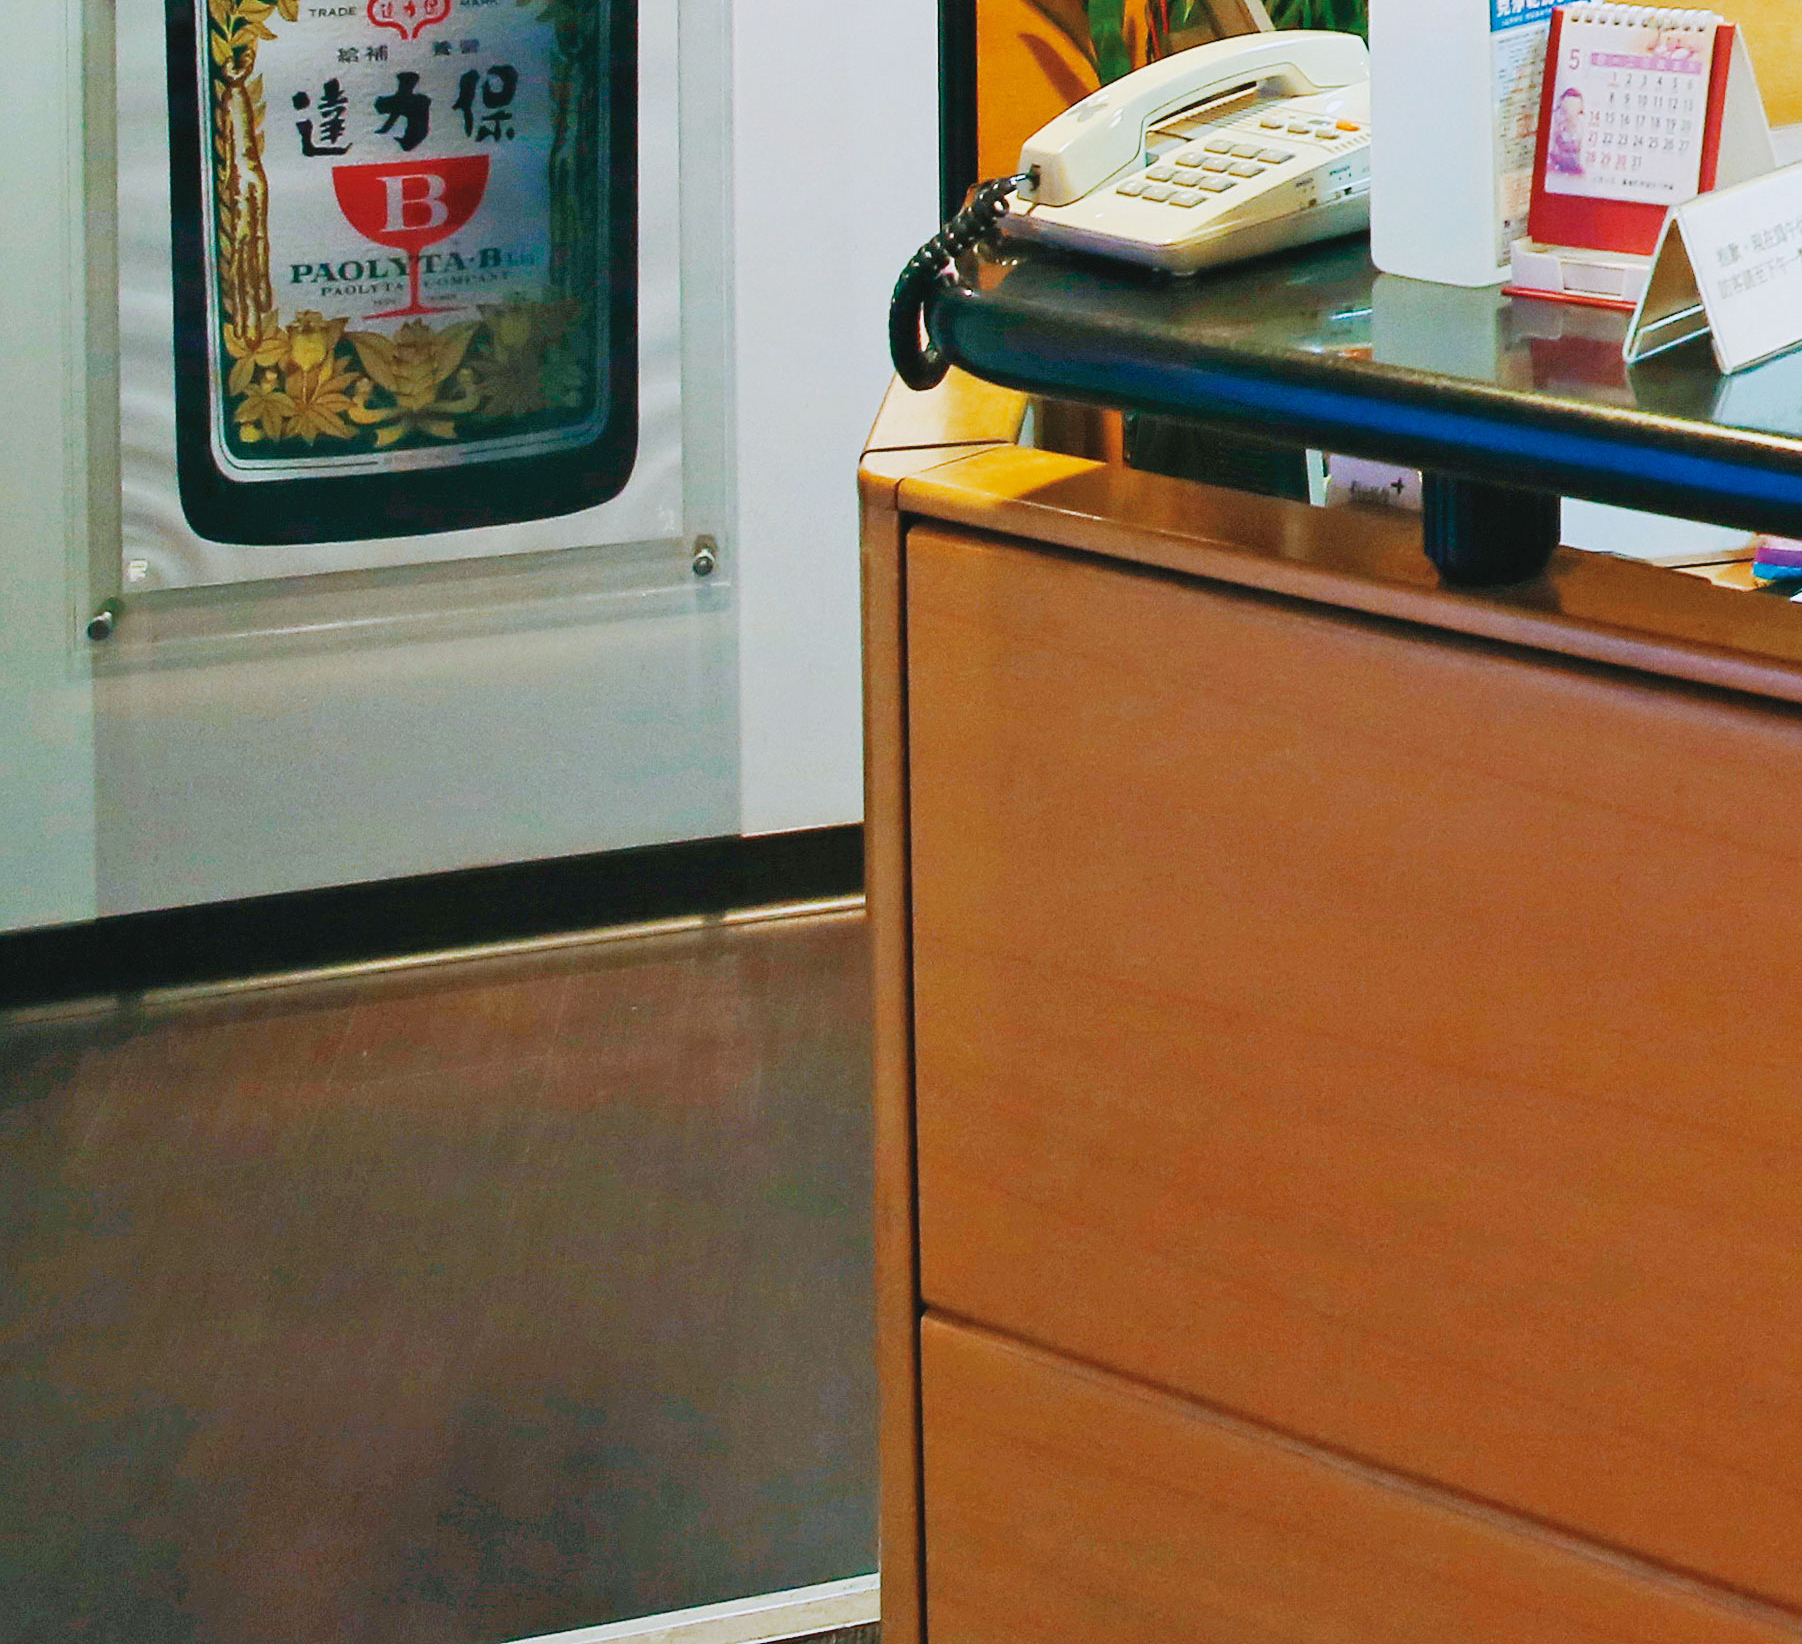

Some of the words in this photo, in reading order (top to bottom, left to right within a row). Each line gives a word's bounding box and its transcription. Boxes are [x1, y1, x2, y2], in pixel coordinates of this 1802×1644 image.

[309, 6, 357, 18] TRADE
[1569, 49, 1580, 70] 5
[376, 174, 449, 233] B
